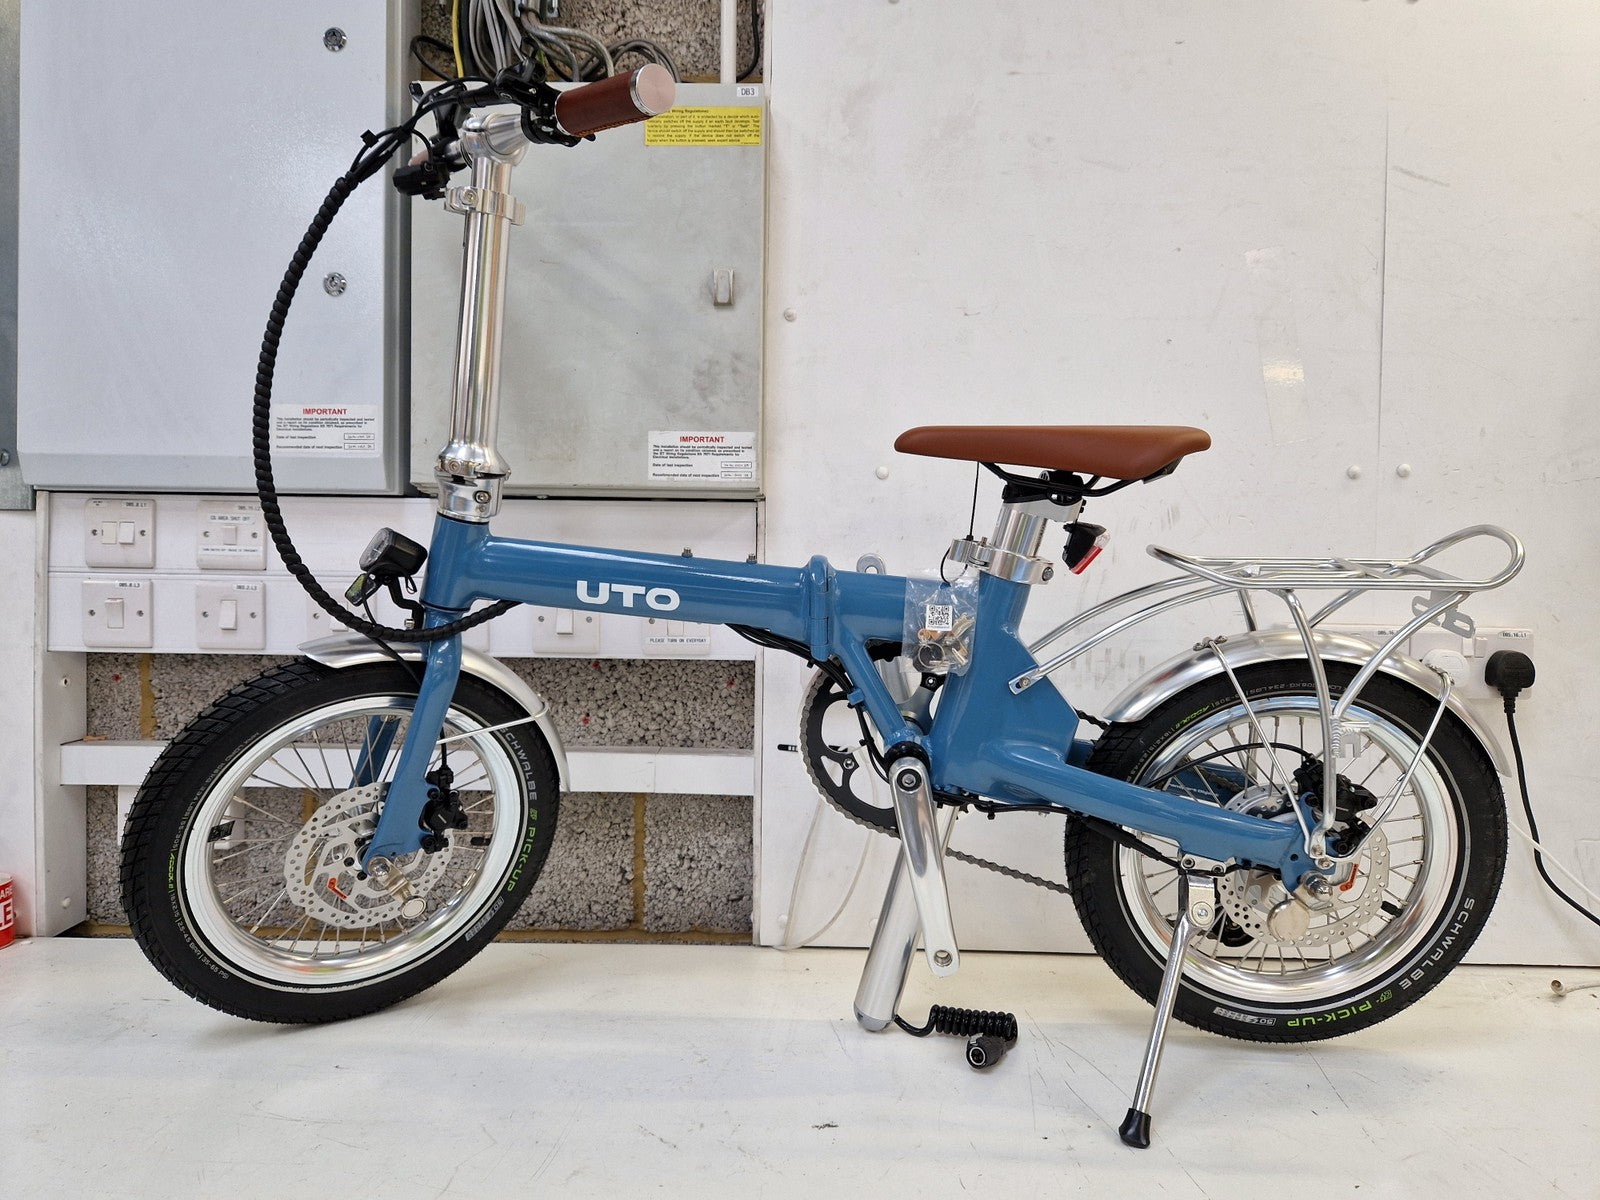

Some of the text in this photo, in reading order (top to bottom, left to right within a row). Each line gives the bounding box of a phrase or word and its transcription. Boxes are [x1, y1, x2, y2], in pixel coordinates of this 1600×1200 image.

[576, 580, 680, 611] UTO
[507, 827, 536, 892] PICK-UP
[1286, 898, 1475, 1027] SCHWALBE PICK-UP
